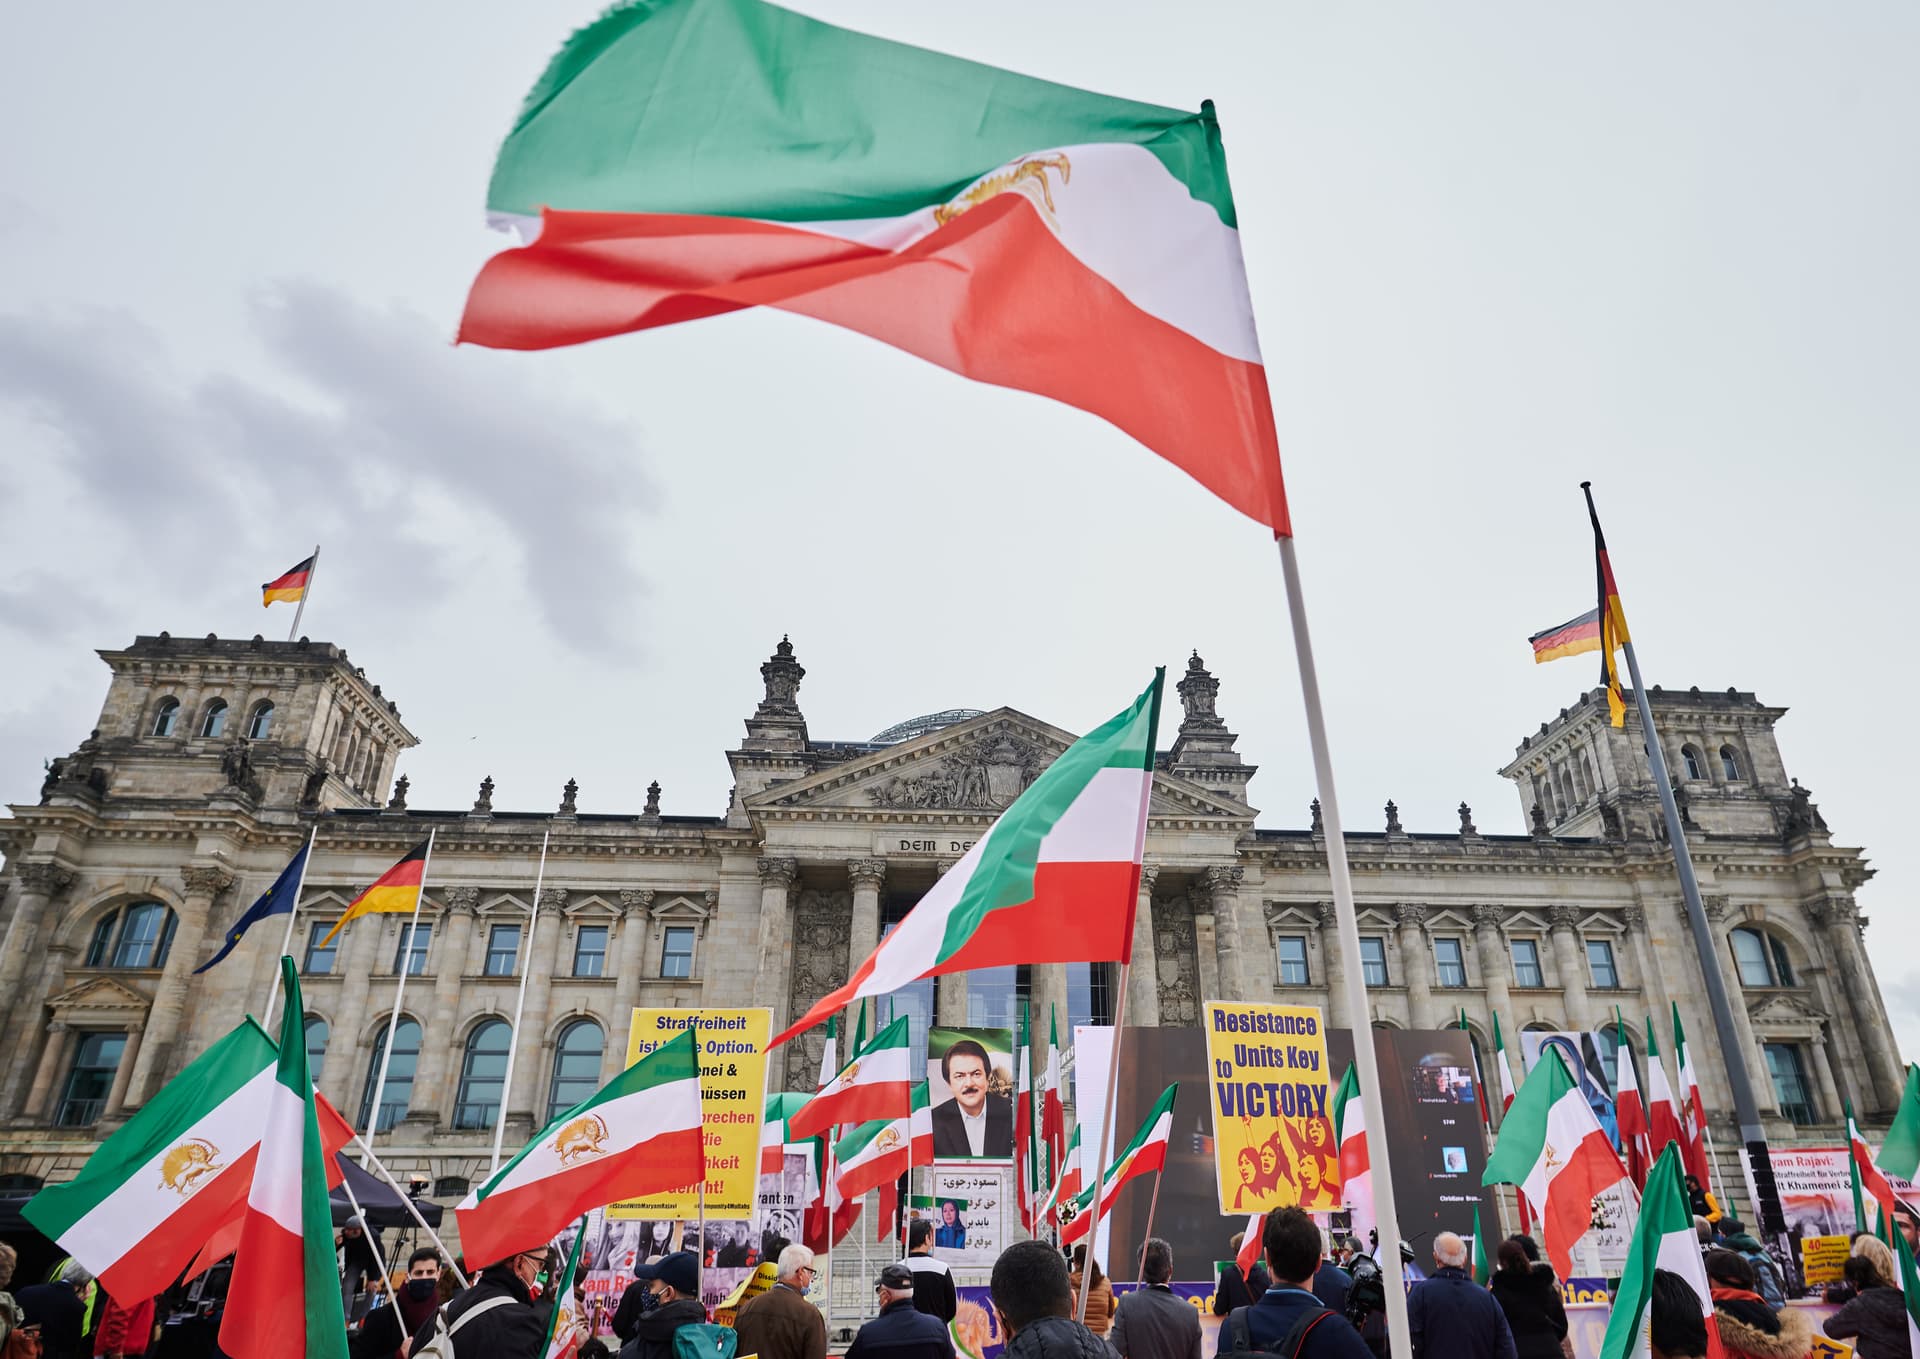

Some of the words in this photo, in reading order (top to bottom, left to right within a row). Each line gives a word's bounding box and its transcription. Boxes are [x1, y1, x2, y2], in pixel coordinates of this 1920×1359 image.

[899, 840, 936, 851] DEM
[950, 841, 977, 852] DE
[656, 1016, 746, 1030] Straffreiheit
[1213, 1008, 1317, 1036] Resistance
[706, 1040, 757, 1056] Option.
[1234, 1044, 1284, 1068] Units
[1286, 1045, 1319, 1071] Key
[726, 1063, 737, 1077] &
[1215, 1058, 1232, 1078] to
[1216, 1082, 1328, 1118] VICTORY
[1795, 1155, 1834, 1168] Rajavi:
[973, 1177, 998, 1187] مسعود
[1788, 1181, 1841, 1191] Khamenei
[1808, 1239, 1821, 1250] 40
